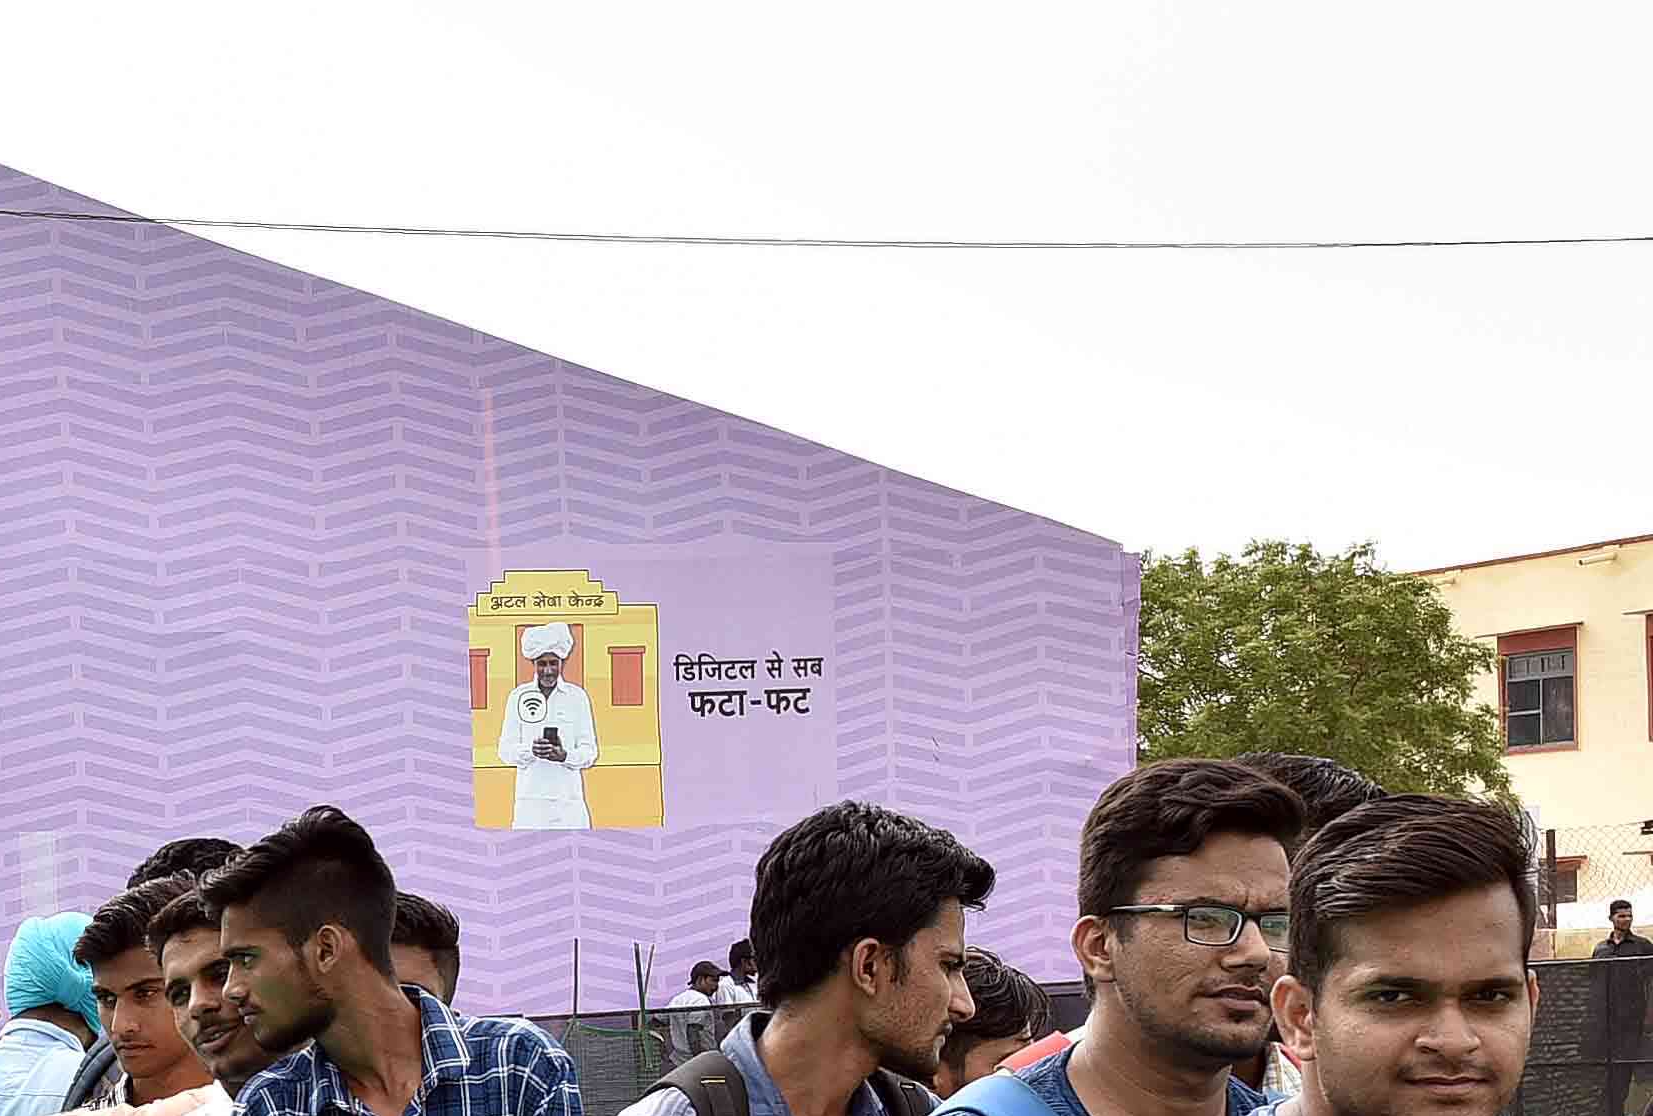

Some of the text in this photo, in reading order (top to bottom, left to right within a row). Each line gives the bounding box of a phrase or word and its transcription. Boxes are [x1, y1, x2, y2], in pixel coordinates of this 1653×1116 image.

[491, 590, 605, 610] अटल सेवा केन्द्र
[673, 651, 824, 682] डिजिटल से सब
[688, 687, 811, 718] फटा-फट
